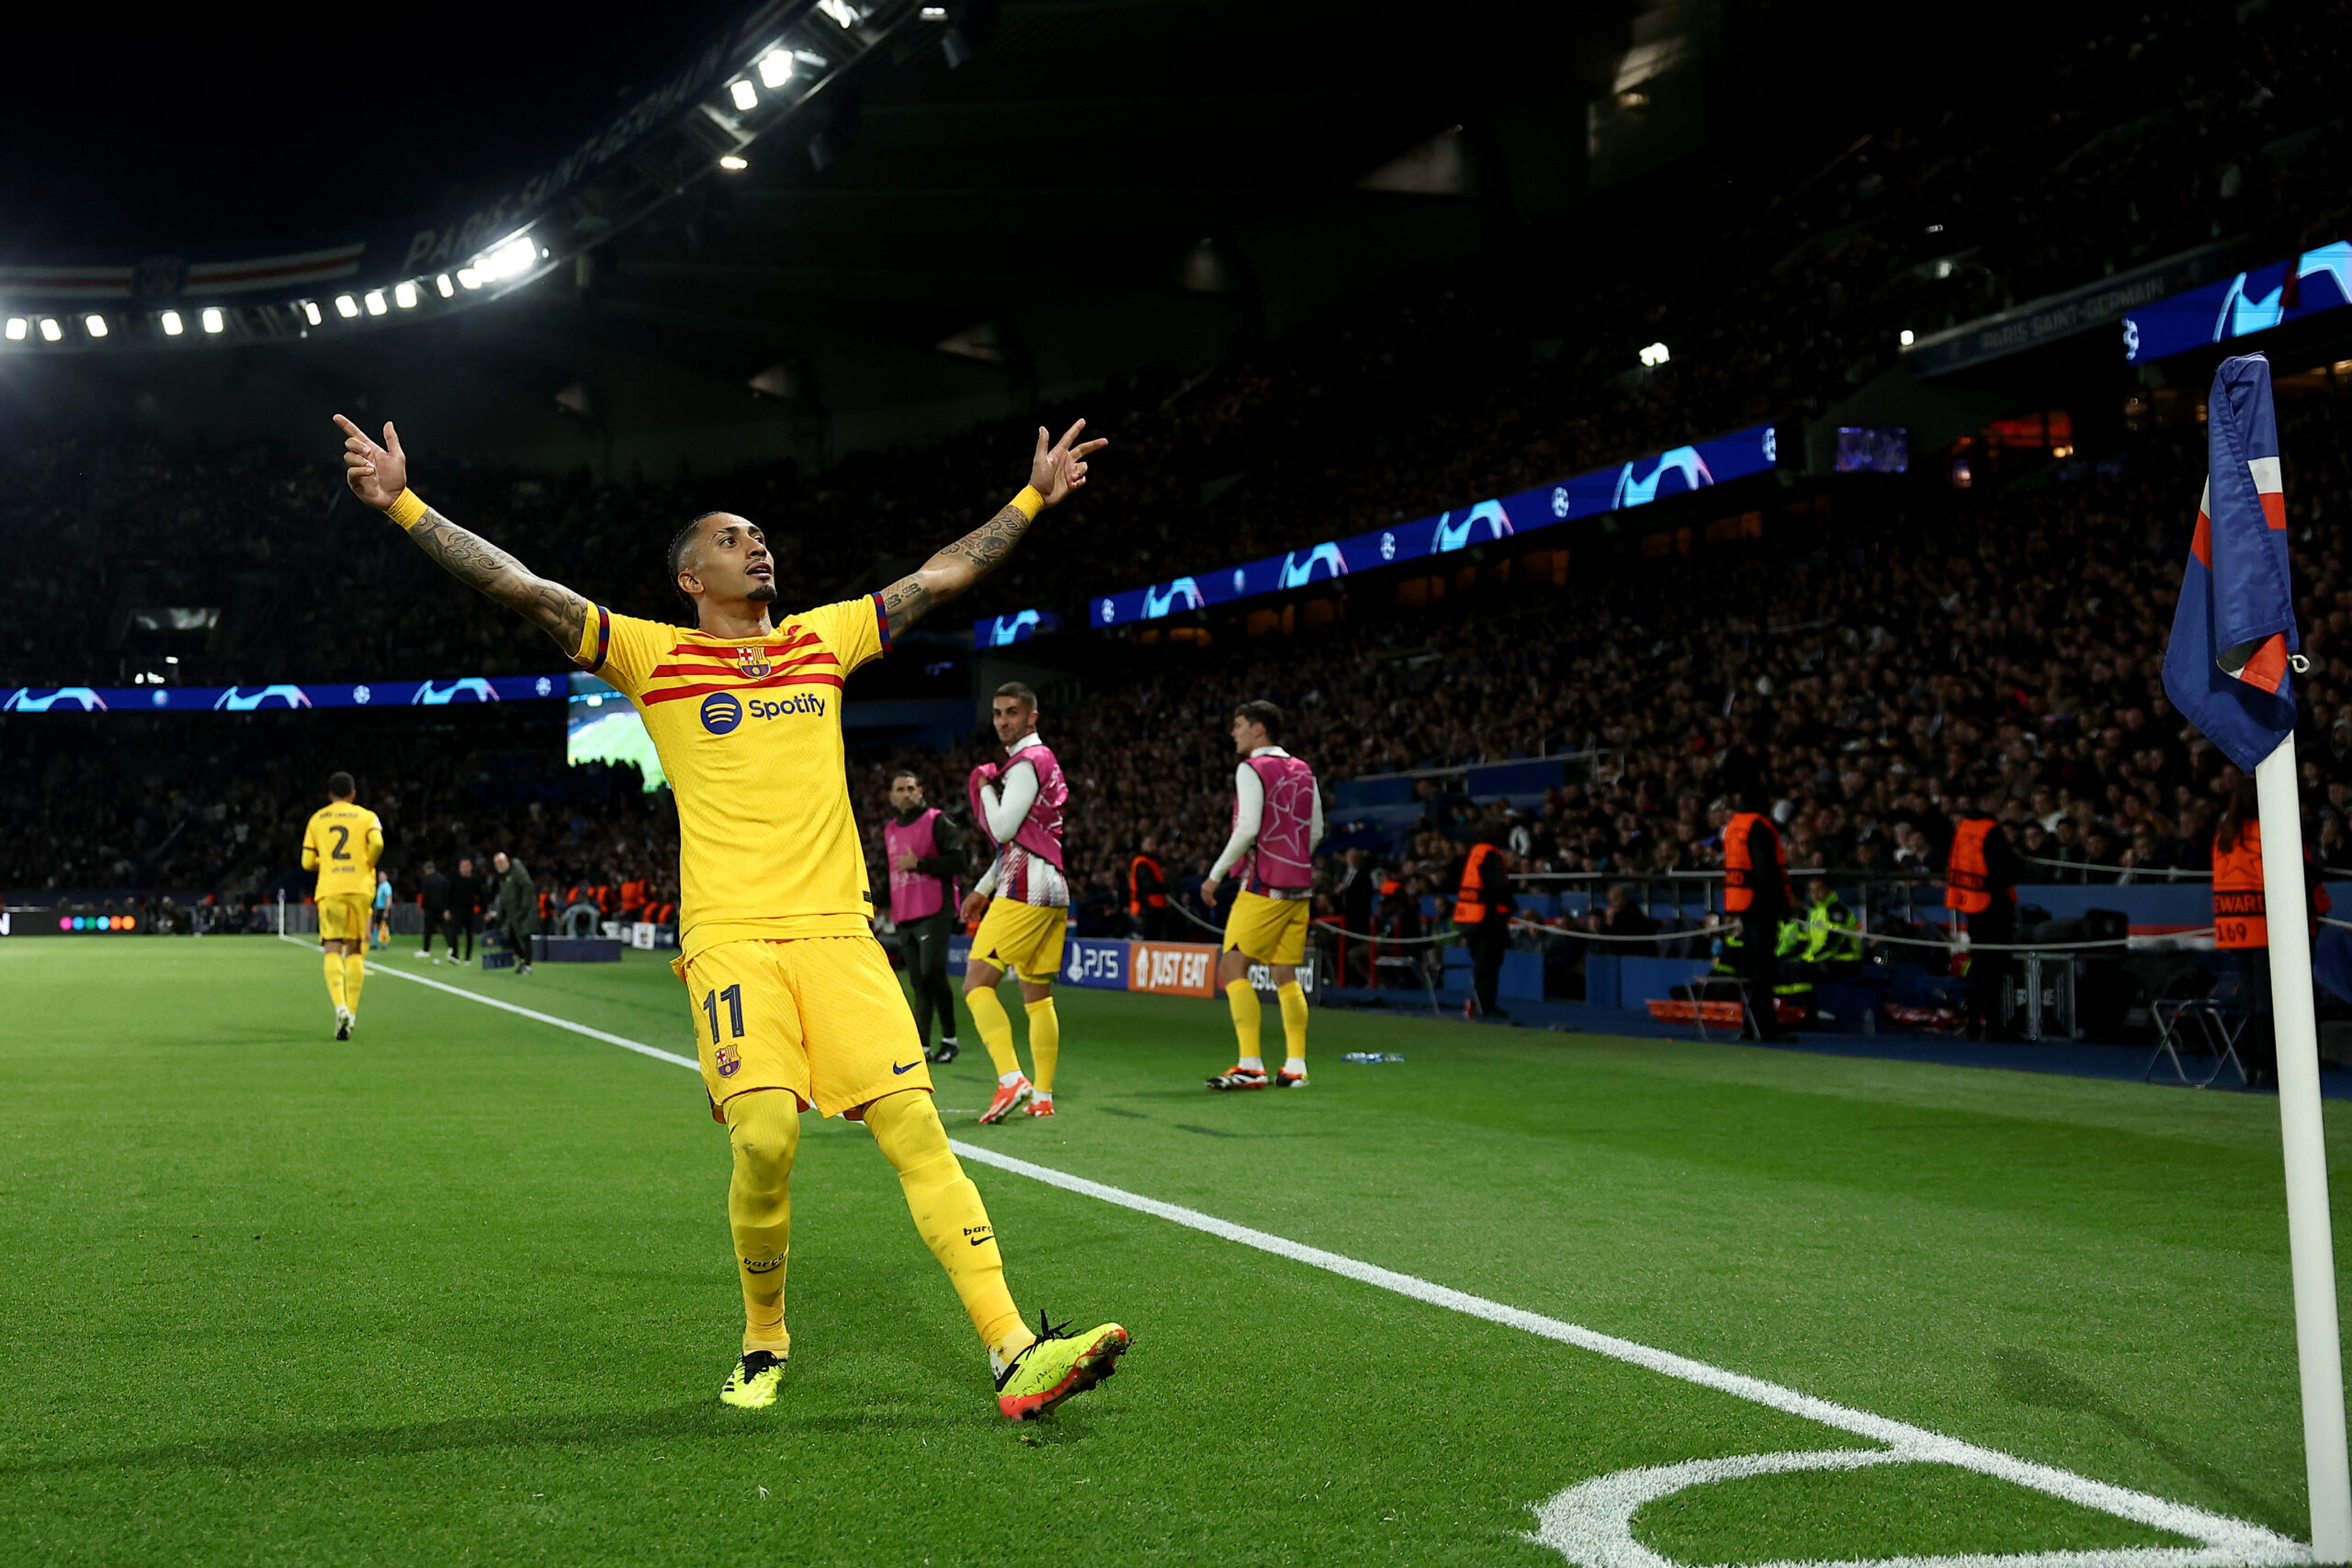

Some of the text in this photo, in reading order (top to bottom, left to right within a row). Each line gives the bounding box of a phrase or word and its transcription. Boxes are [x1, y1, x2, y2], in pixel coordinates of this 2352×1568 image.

[749, 693, 825, 720] Spotify
[328, 825, 352, 860] 2
[2217, 922, 2247, 942] 169
[1083, 947, 1120, 980] PS5
[1149, 949, 1210, 990] JUST EAT
[703, 984, 745, 1045] 11
